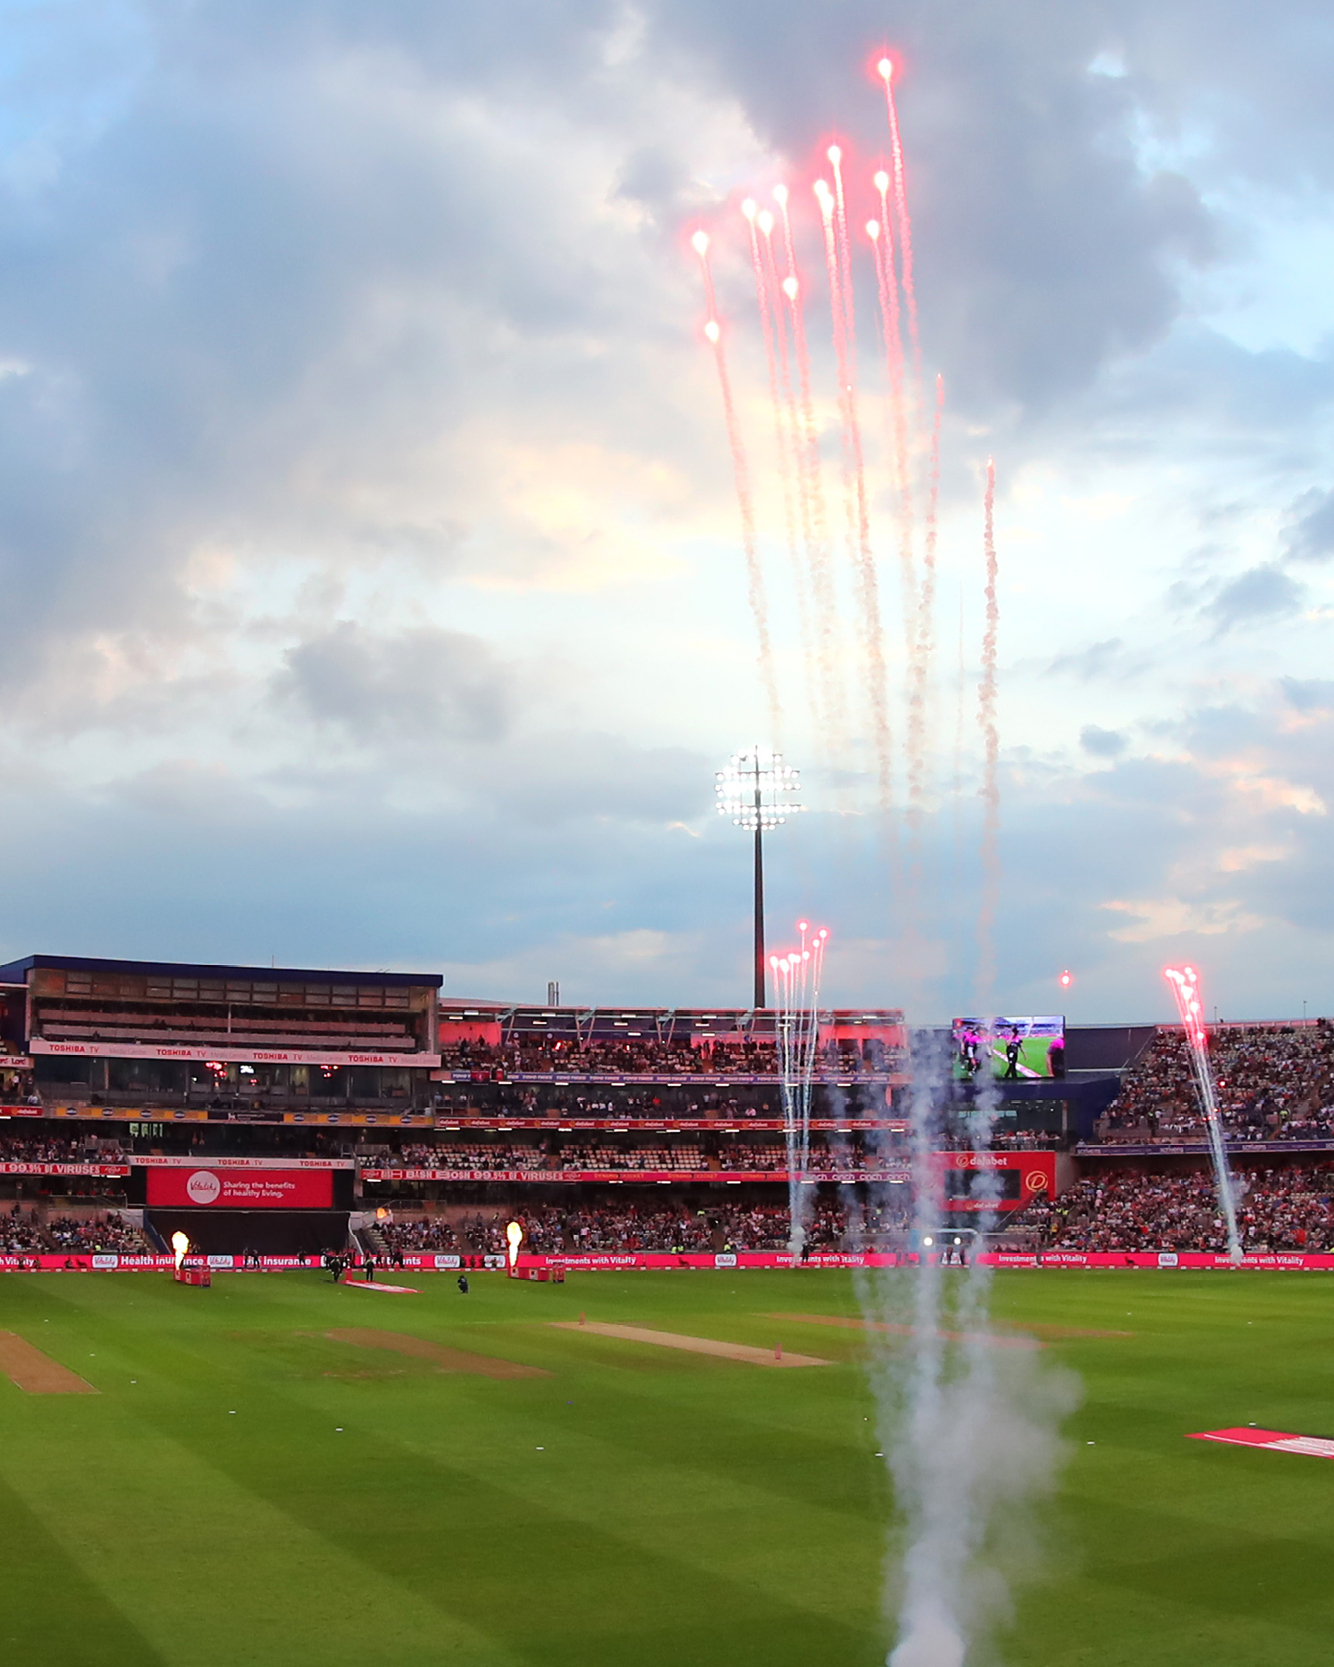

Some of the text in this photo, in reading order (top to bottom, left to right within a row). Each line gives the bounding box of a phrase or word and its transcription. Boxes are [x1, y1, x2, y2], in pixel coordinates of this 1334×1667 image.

[49, 1044, 85, 1052] TOSHIBA
[253, 1052, 288, 1060] TOSHIBA
[970, 1156, 1008, 1166] dafabet
[57, 1165, 100, 1174] VIRUSES
[521, 1172, 563, 1180] VIRUSES
[832, 1173, 855, 1181] cinch
[859, 1173, 882, 1181] cinch
[191, 1181, 217, 1192] Vitality
[223, 1181, 296, 1191] Sharing the benefits
[223, 1189, 284, 1199] of healthy living.
[121, 1256, 154, 1266] Health
[263, 1256, 311, 1266] insurane
[592, 1256, 609, 1264] with
[1045, 1254, 1061, 1262] with
[1061, 1255, 1087, 1264] Vitality
[1215, 1256, 1304, 1266] Inveents with Vitality
